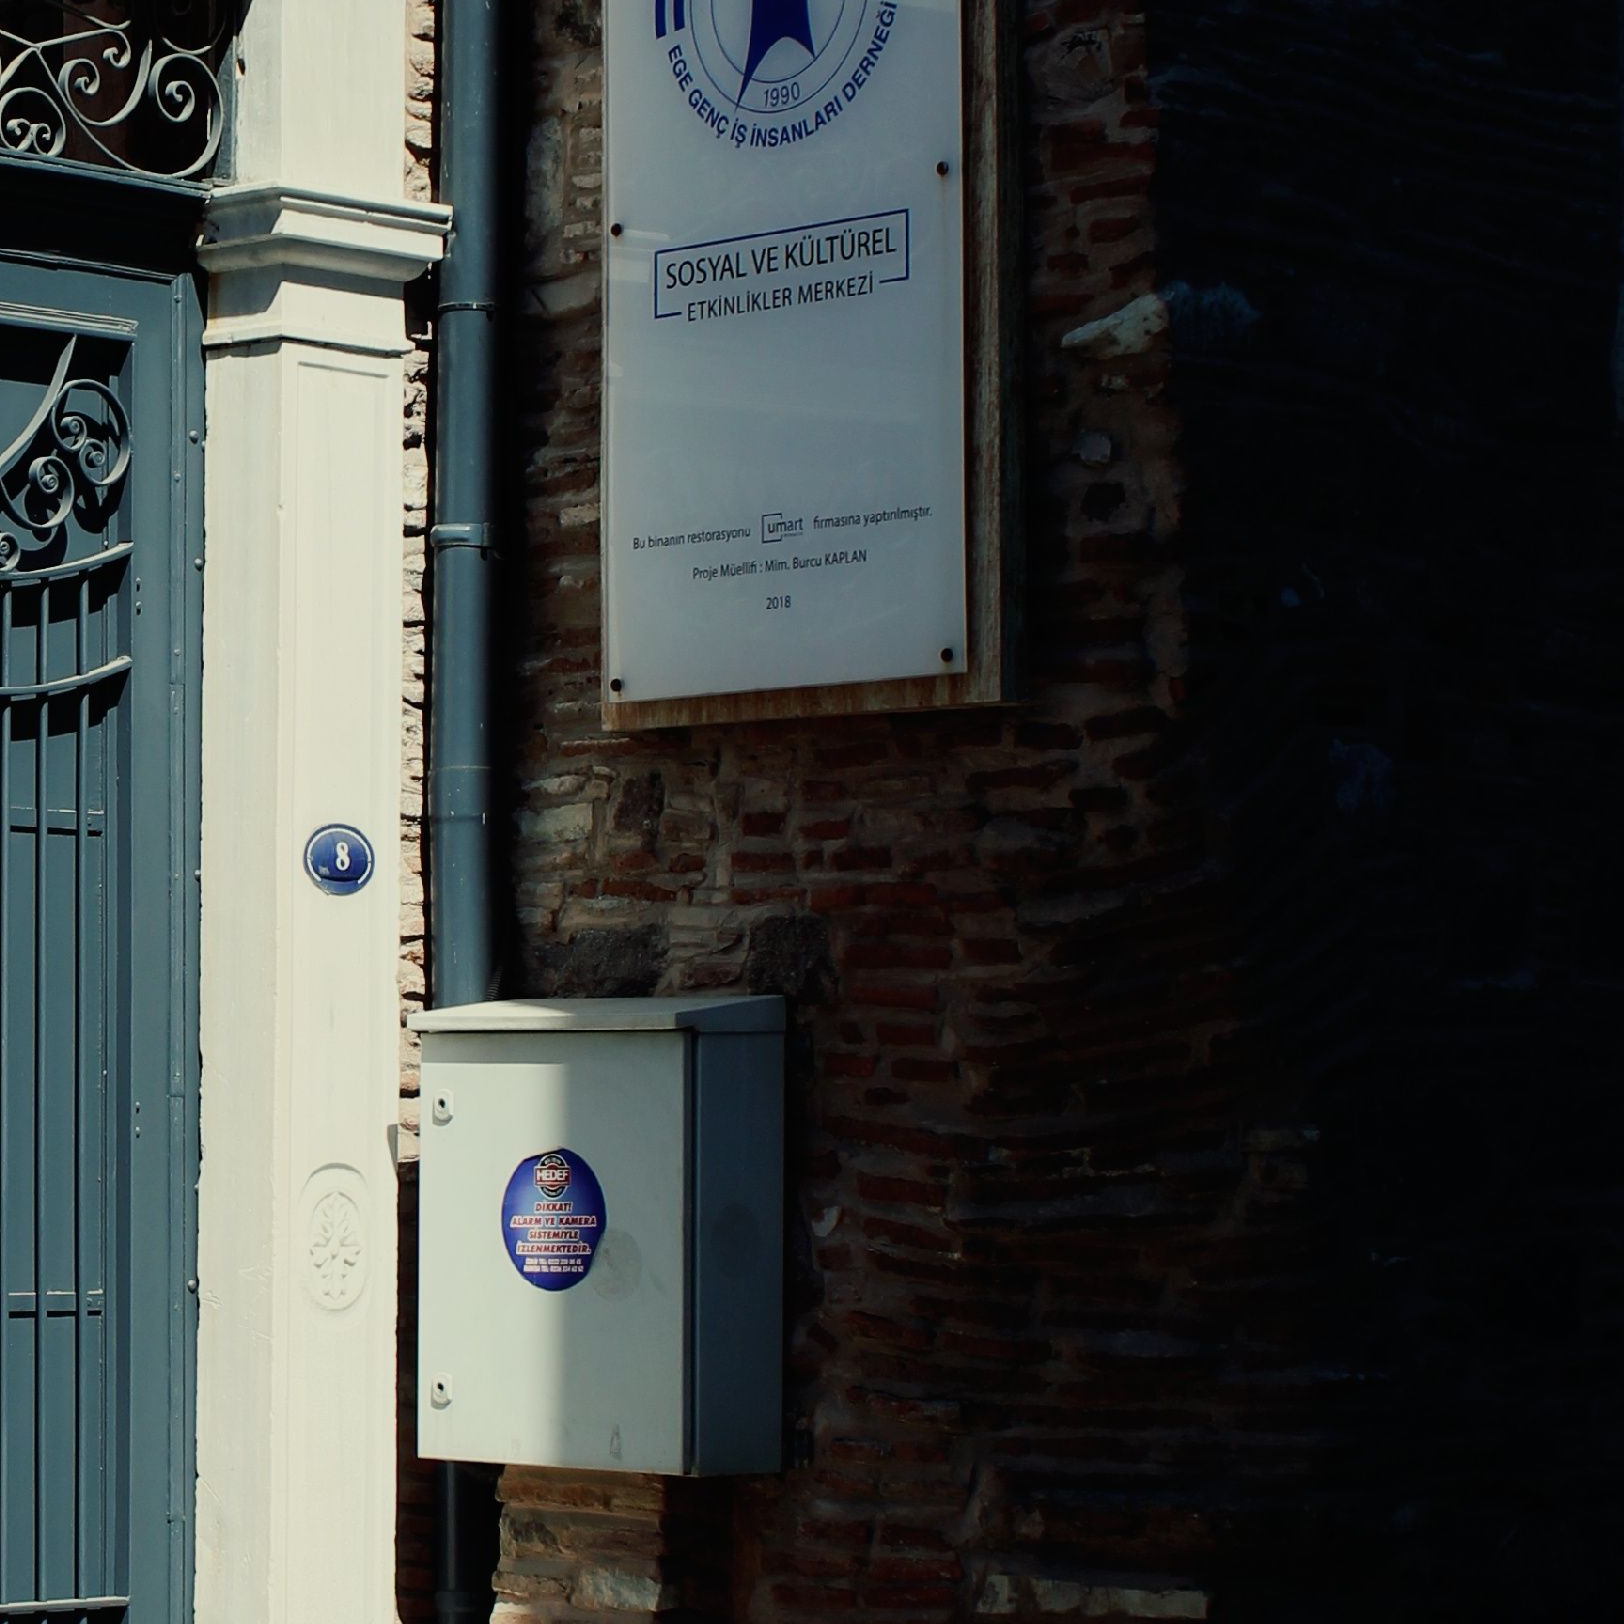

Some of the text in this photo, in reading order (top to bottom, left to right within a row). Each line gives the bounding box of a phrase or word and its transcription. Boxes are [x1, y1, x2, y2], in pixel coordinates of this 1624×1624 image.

[668, 0, 898, 148] EGE GENÇ İŞ İNSANLARI DERNEĞİ
[764, 82, 800, 108] 1990
[666, 227, 897, 289] SOSYAL VE KÜLTÜREL
[687, 271, 873, 322] ETKİNLİKLER MERKEZİ
[633, 537, 646, 550] Bu
[687, 527, 751, 543] restorasyonu
[767, 518, 804, 534] umart
[692, 566, 719, 581] Proje
[793, 556, 822, 570] Burcu
[825, 549, 868, 566] KAPLAN
[765, 595, 792, 610] 2018
[336, 841, 351, 871] 8
[536, 1169, 570, 1181] HEDEF
